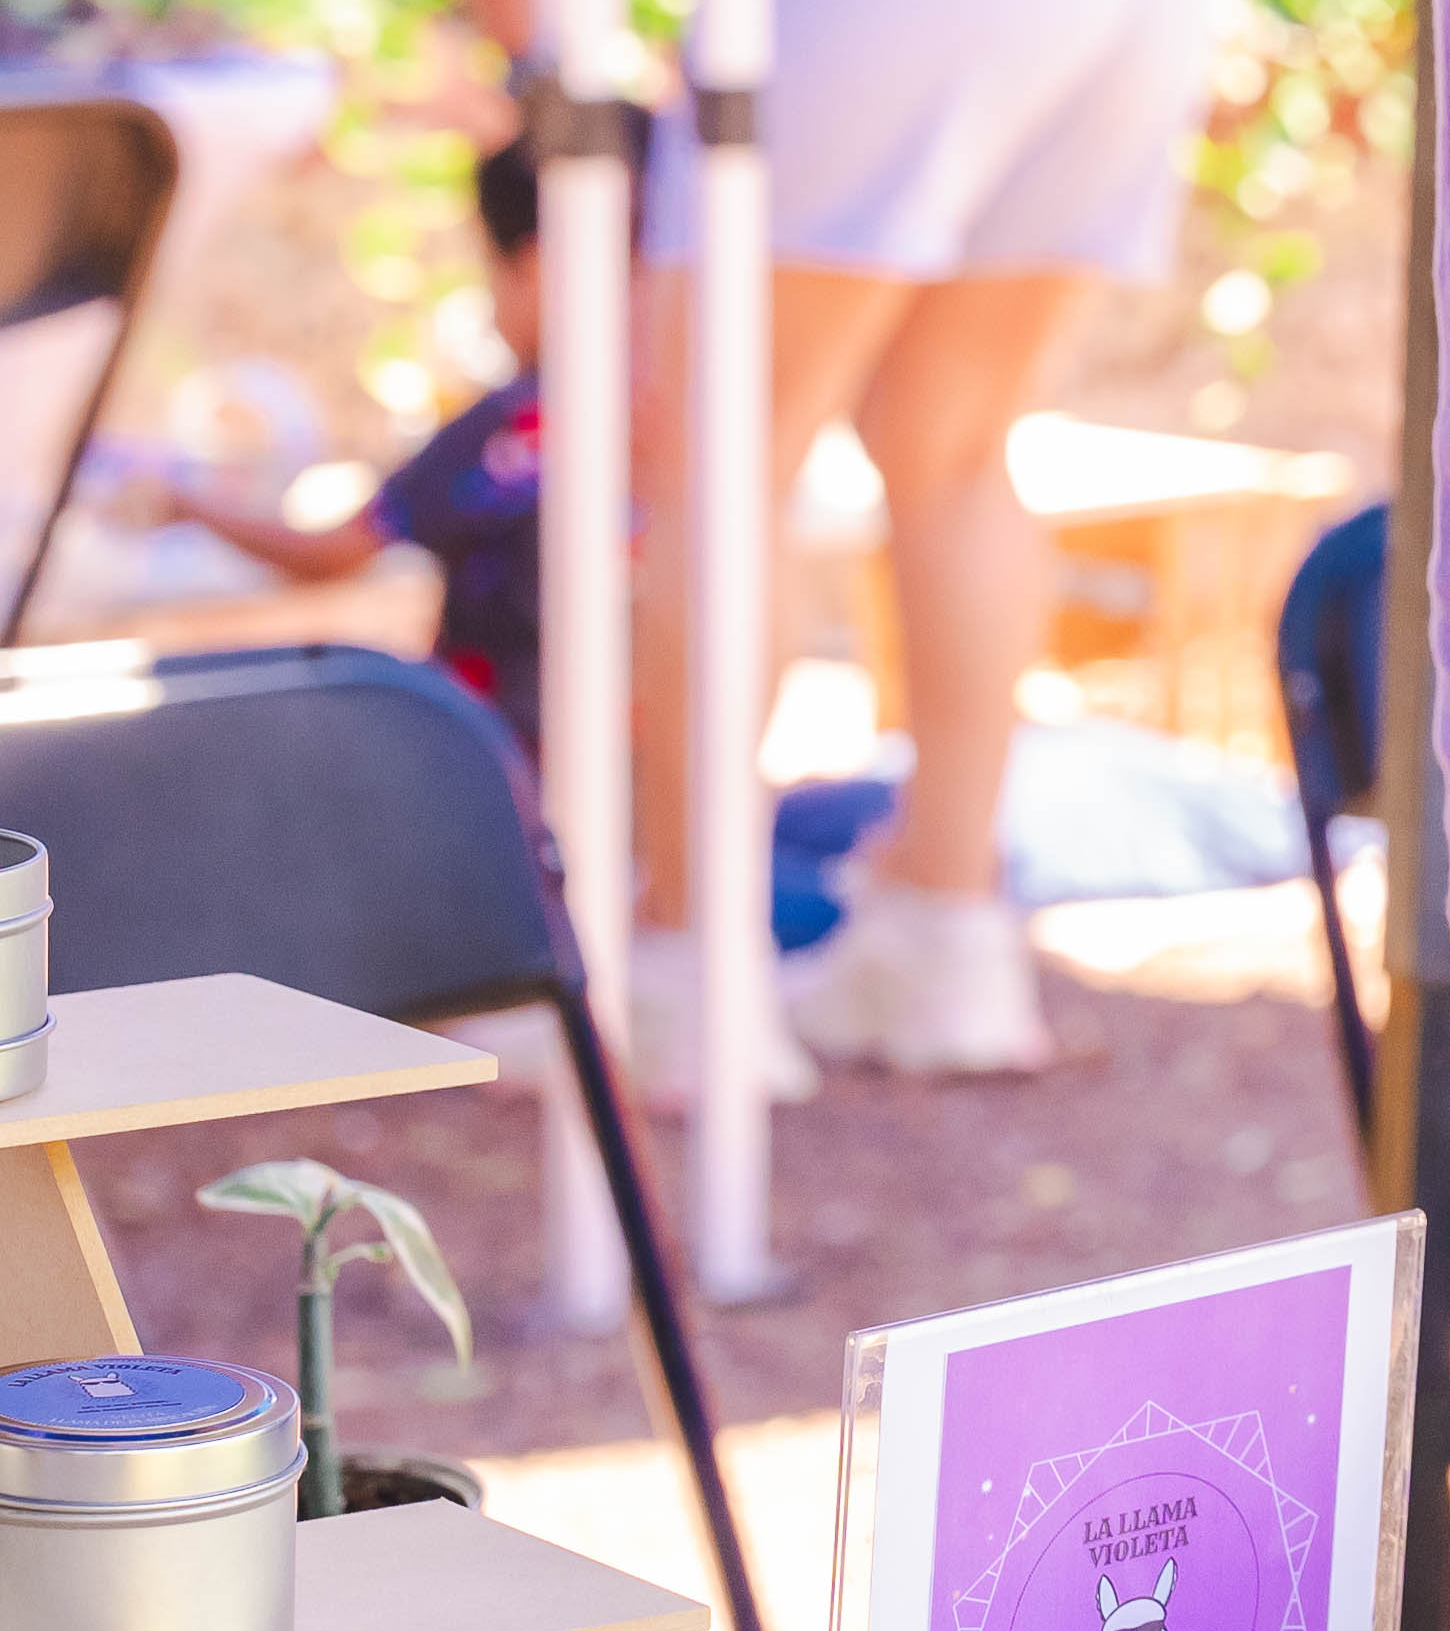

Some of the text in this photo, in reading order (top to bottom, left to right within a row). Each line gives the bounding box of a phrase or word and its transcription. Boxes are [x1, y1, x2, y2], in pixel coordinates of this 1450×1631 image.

[1083, 1497, 1198, 1544] LA LLAMA
[1089, 1525, 1189, 1567] VIOLETA
